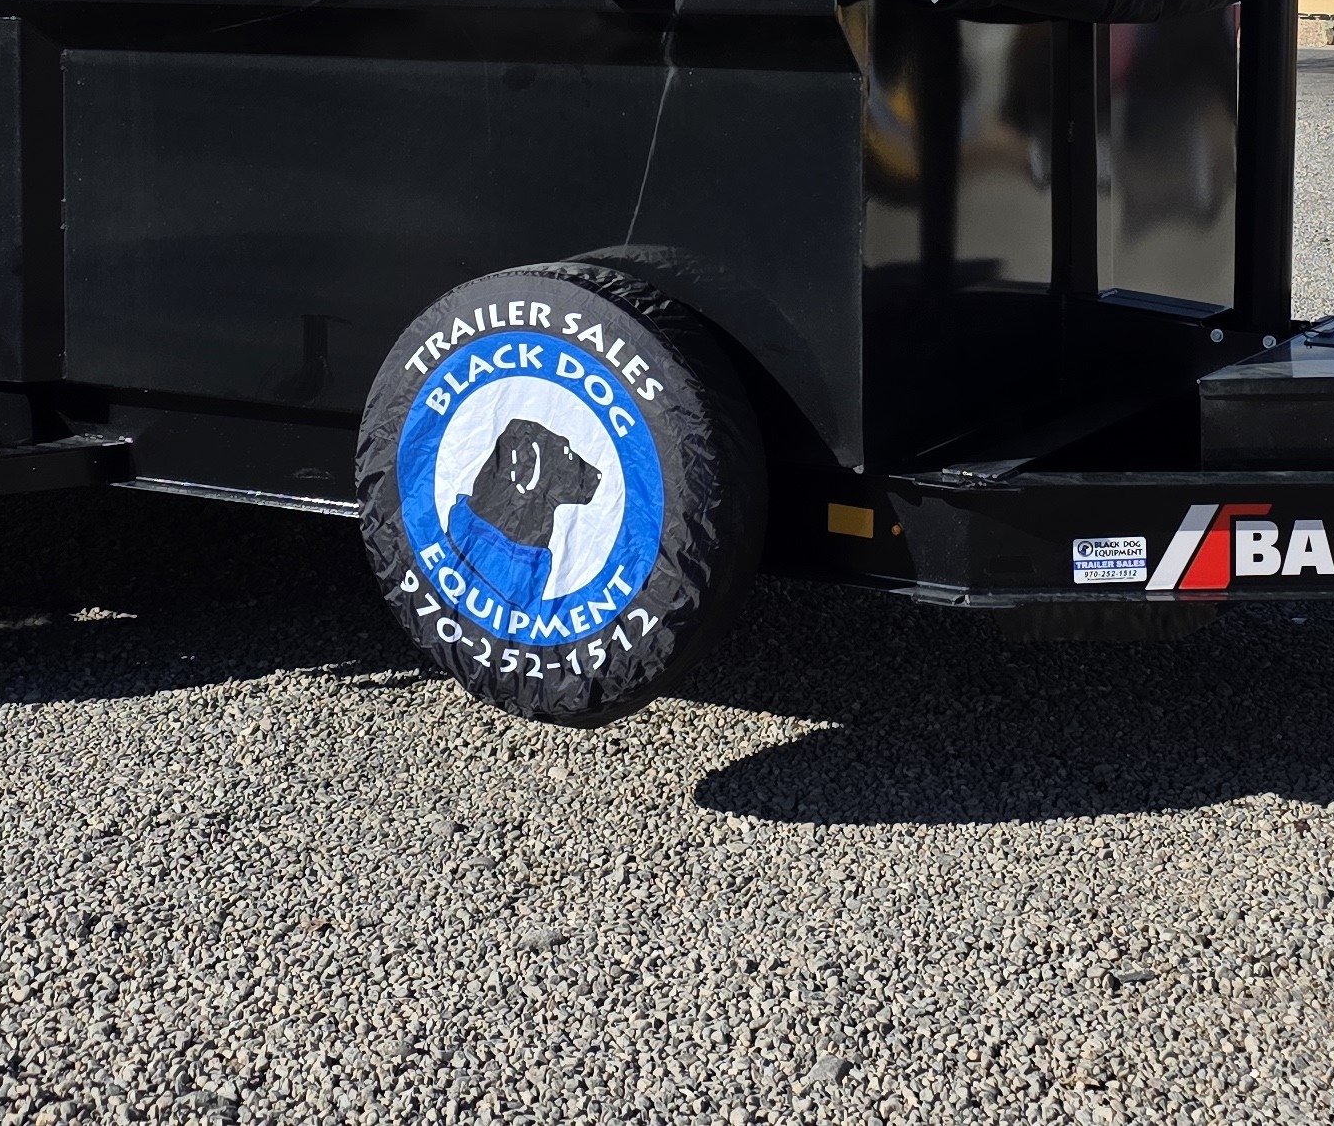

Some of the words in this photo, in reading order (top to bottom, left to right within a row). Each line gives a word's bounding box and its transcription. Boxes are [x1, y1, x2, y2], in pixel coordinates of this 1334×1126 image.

[405, 301, 551, 374] TRAILER
[562, 312, 664, 402] SALES
[425, 343, 543, 415] BLACK
[555, 352, 635, 437] DOG
[419, 544, 633, 640] EQUIPMENT
[1075, 561, 1114, 569] TRAILER
[1084, 570, 1138, 578] 970-252-1512
[1095, 549, 1143, 557] EQUIPMENT
[400, 570, 659, 679] 970-252-1512
